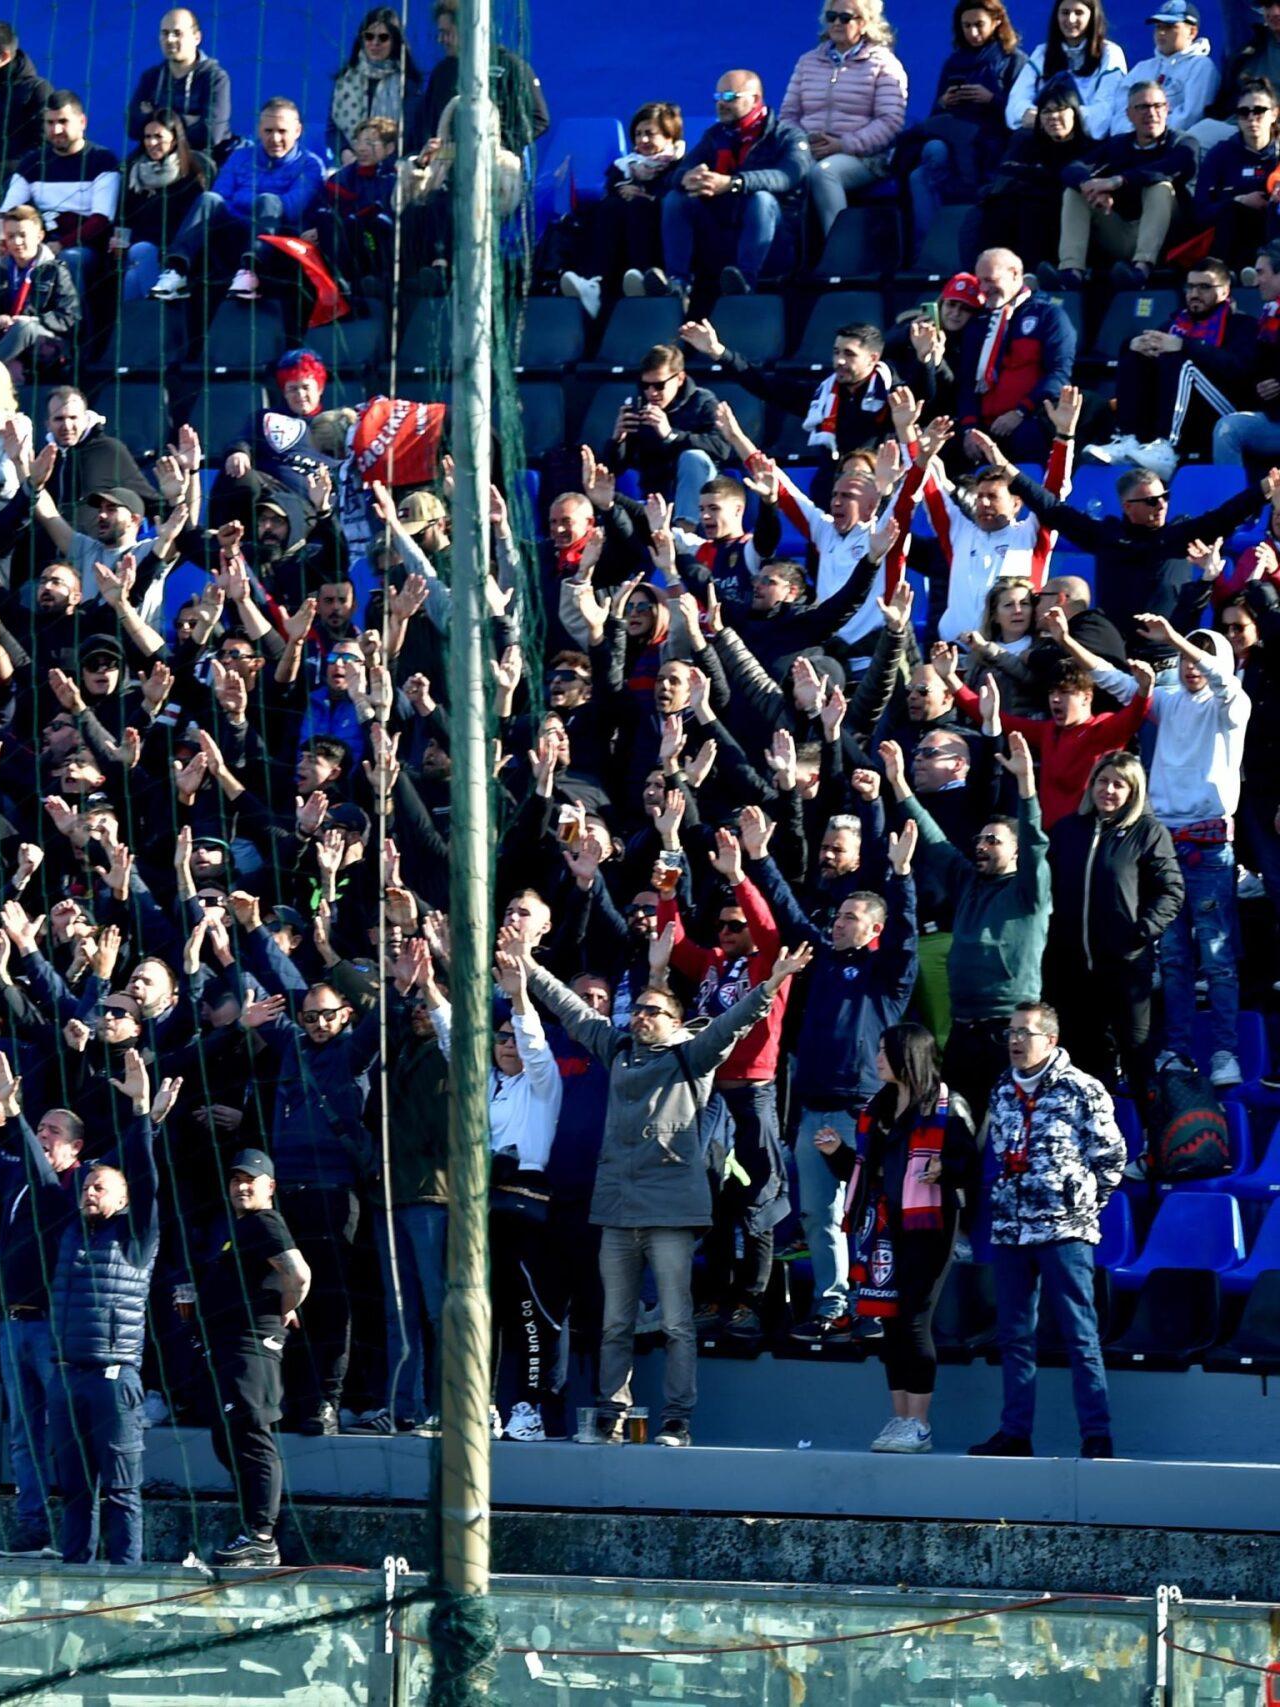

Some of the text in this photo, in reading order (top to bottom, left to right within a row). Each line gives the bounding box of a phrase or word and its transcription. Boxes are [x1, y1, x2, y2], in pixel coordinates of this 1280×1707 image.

[859, 1287, 899, 1298] macron
[521, 1300, 533, 1317] DO
[528, 1357, 540, 1388] BEST
